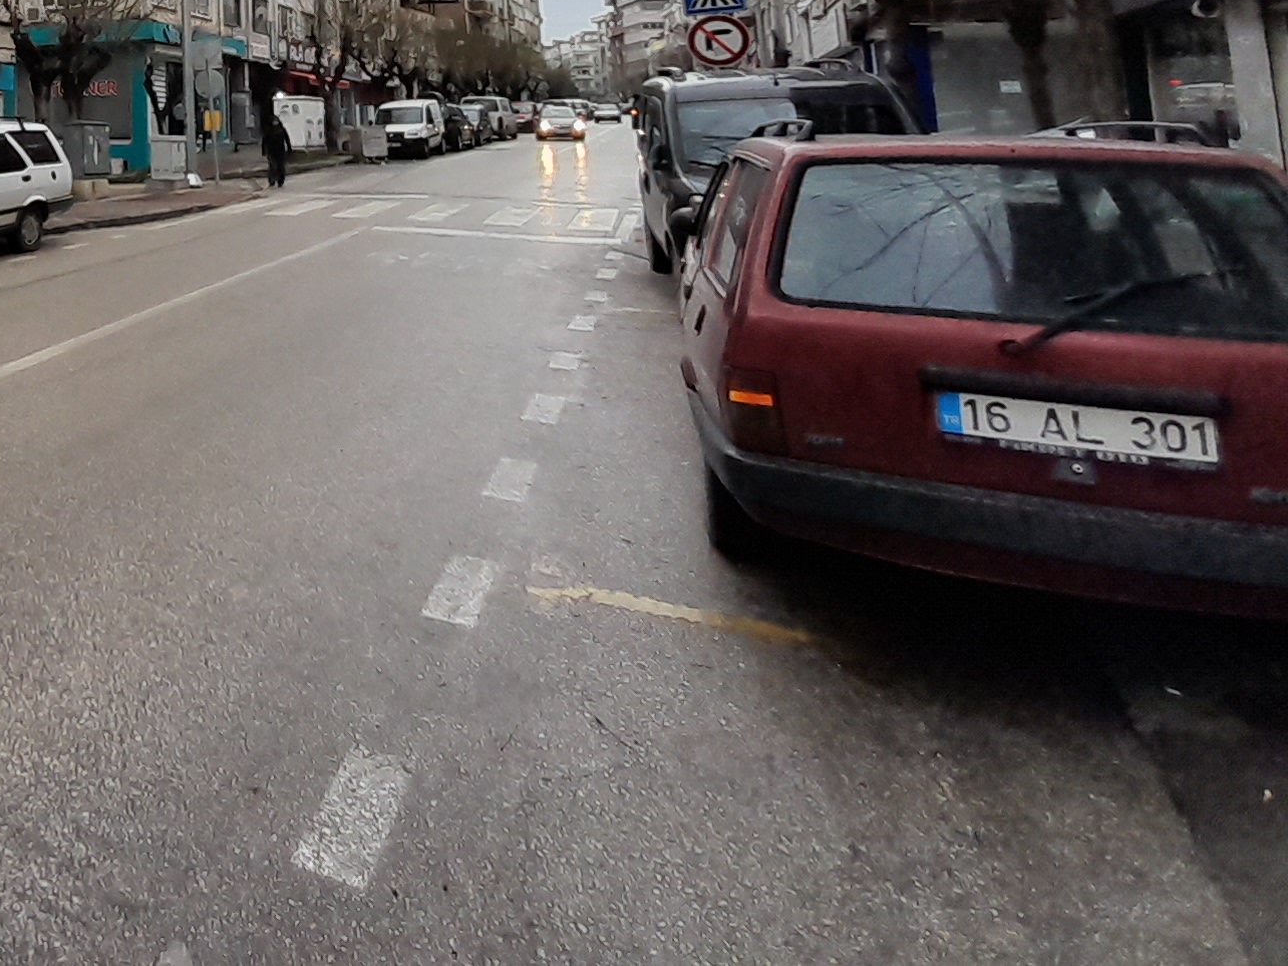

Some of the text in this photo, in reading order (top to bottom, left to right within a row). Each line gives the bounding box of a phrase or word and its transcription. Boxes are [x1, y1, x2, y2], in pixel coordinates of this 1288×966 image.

[963, 398, 1011, 434] 16
[1040, 407, 1105, 445] AL
[1130, 416, 1209, 457] 301
